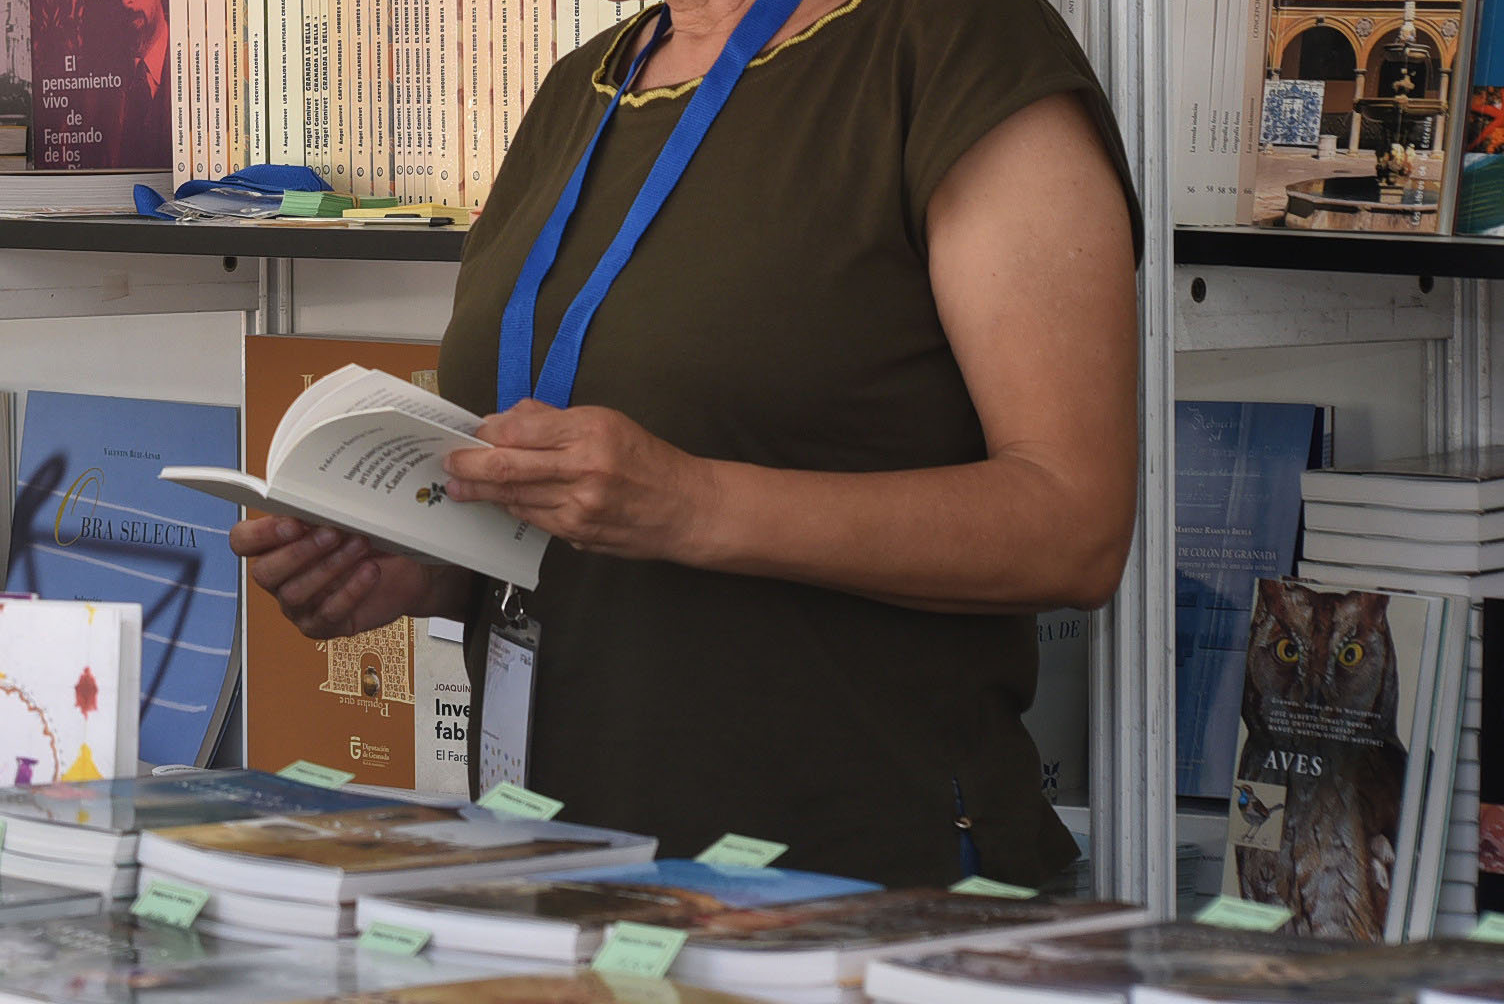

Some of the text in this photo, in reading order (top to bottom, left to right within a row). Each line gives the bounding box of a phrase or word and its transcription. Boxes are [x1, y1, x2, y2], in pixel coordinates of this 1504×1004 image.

[305, 45, 311, 55] LA
[322, 44, 328, 55] LA
[64, 54, 76, 72] El
[42, 72, 122, 94] pensamiento
[42, 92, 69, 109] vivo
[66, 109, 83, 126] de
[44, 126, 103, 145] Fernando
[44, 145, 81, 163] de los
[119, 519, 197, 549] SELECTA
[1234, 550, 1278, 561] GRANADA
[362, 742, 390, 753] Diputación
[368, 751, 390, 761] Granada
[436, 749, 447, 761] El
[1263, 749, 1324, 777] AVES
